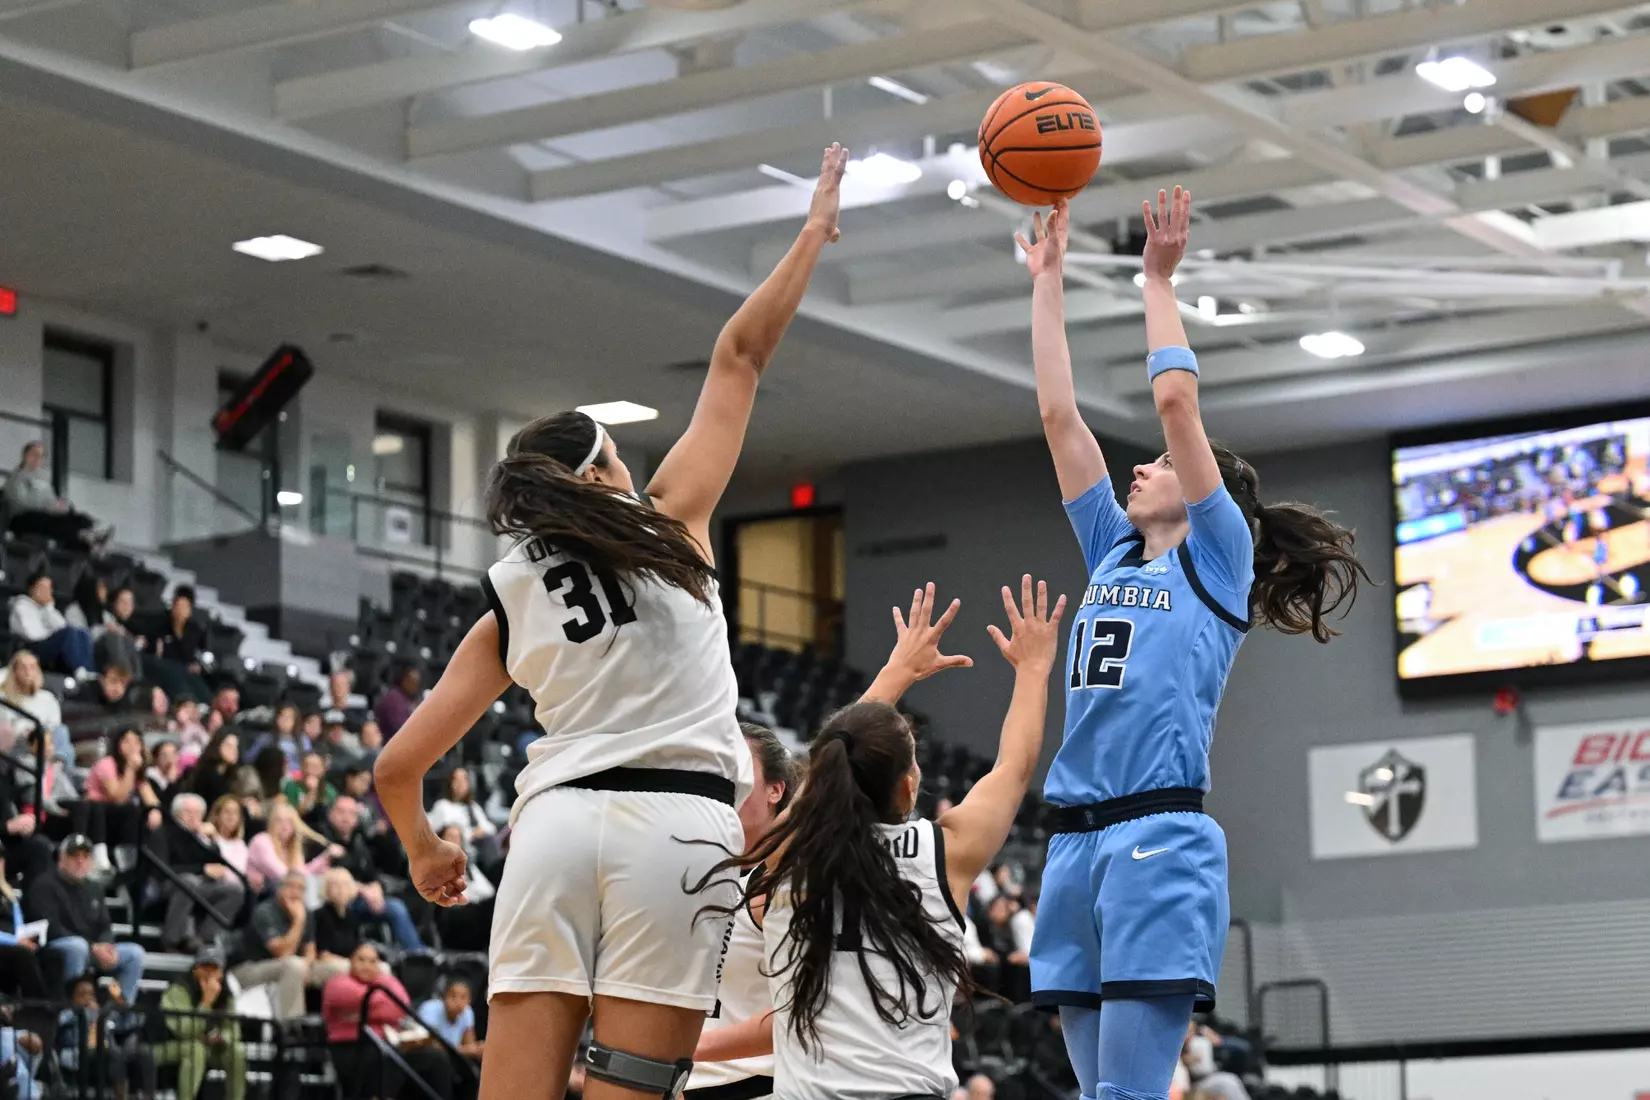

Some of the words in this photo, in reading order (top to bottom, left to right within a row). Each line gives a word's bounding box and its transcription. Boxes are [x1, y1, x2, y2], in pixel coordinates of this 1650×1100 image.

[1035, 112, 1096, 134] ELITE
[542, 561, 638, 644] 31
[1070, 617, 1135, 691] 12
